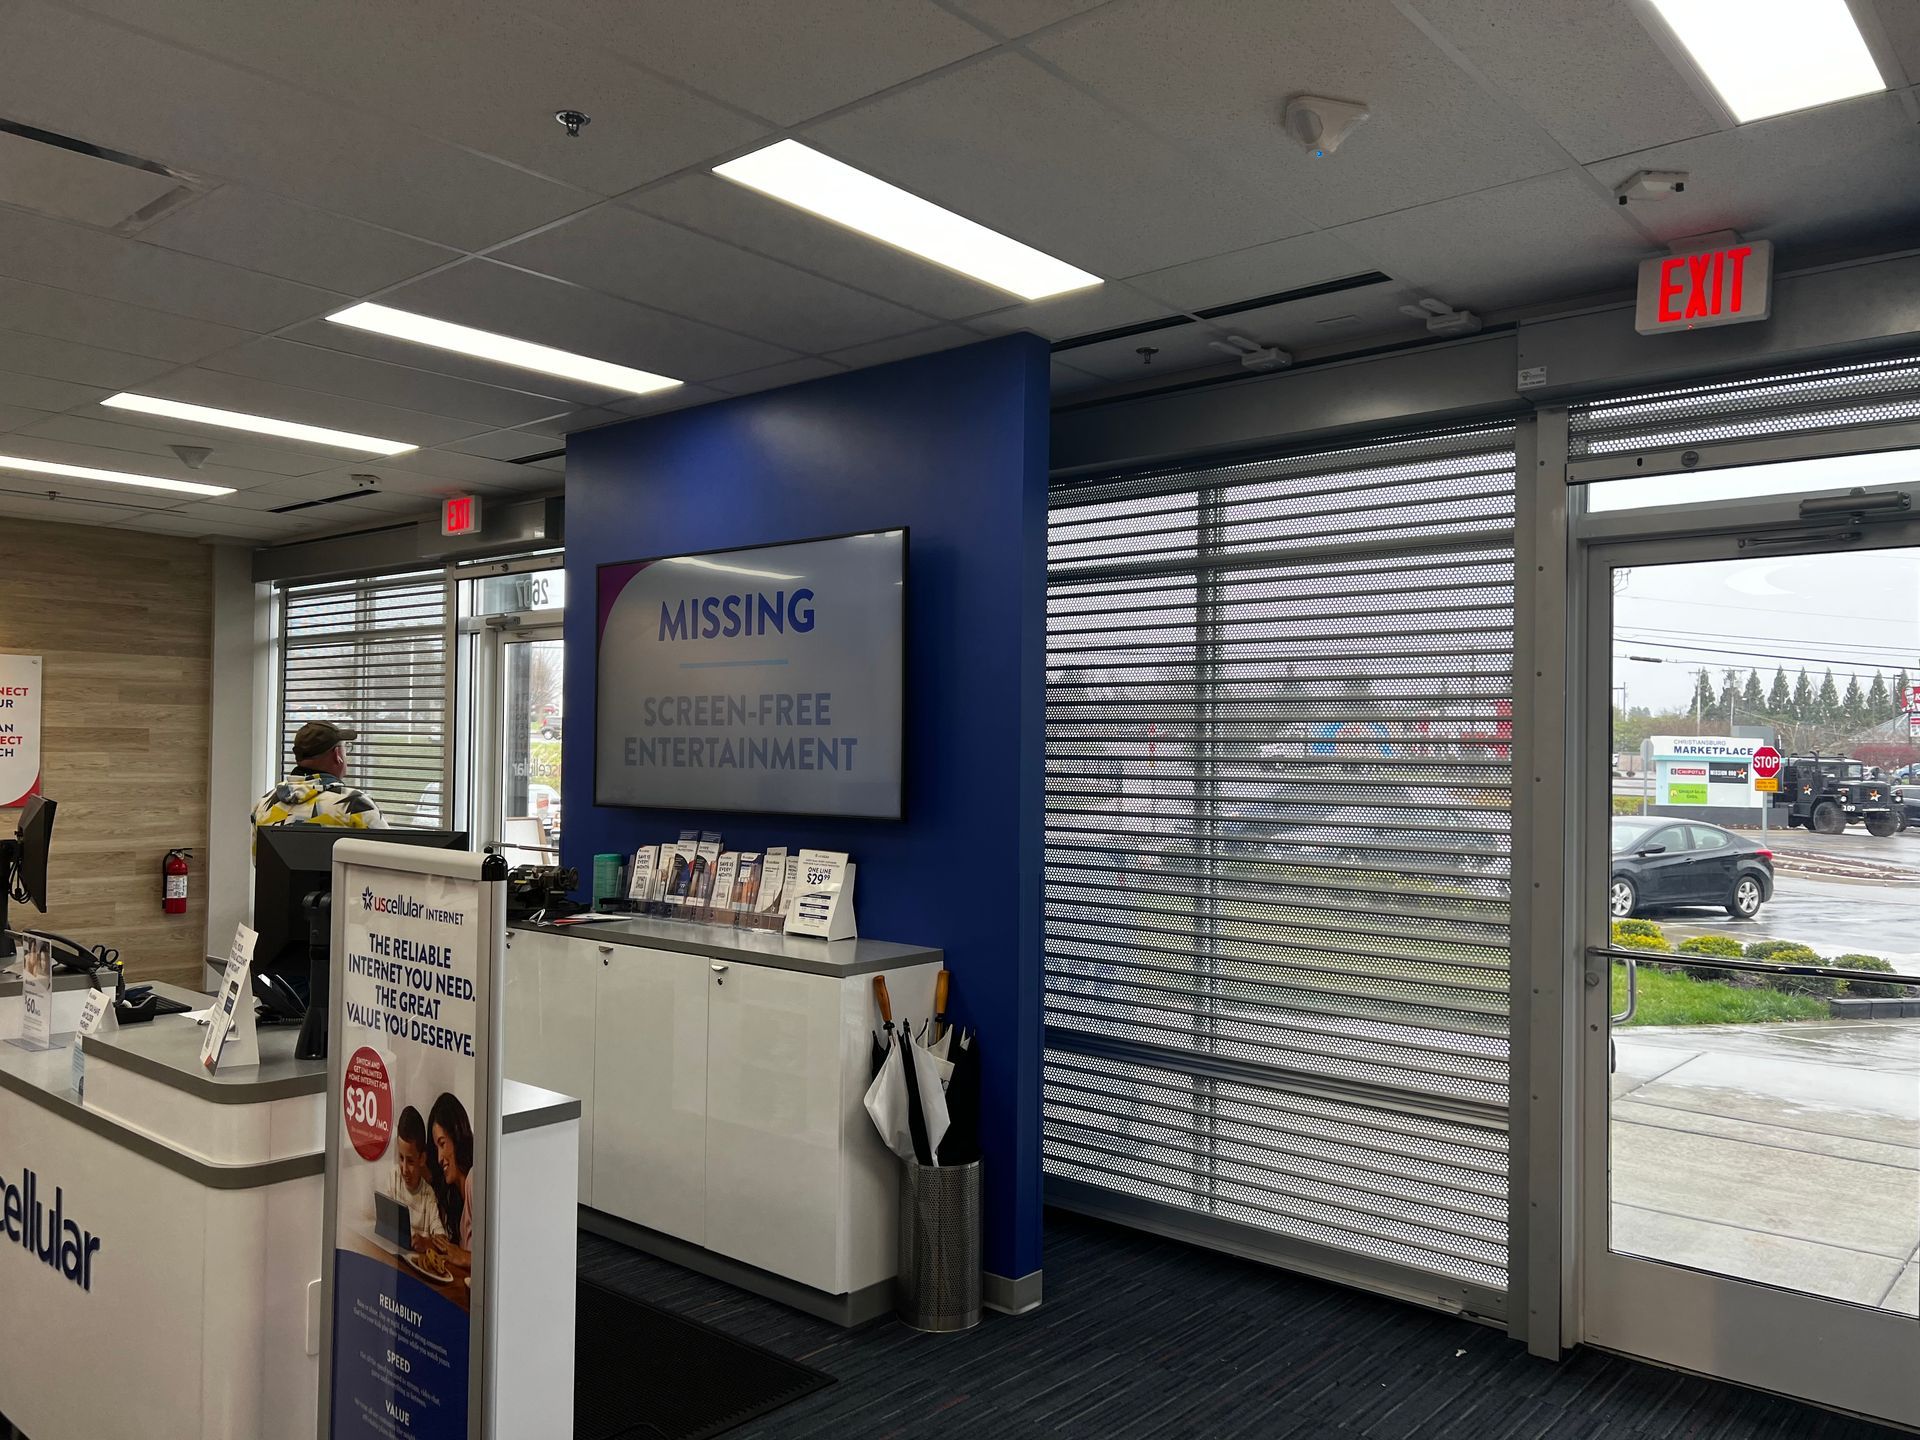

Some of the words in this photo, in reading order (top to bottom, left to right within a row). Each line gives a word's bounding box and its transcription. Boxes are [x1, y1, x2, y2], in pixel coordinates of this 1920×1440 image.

[1658, 247, 1752, 322] EXIT
[447, 497, 473, 532] EXIT
[658, 588, 815, 642] MISSING
[644, 693, 831, 727] SCREEN-FREE
[624, 737, 857, 771] ENTERTAINMENT
[1673, 746, 1753, 756] MARKETPLACE
[1754, 756, 1779, 768] STOP
[808, 866, 819, 874] ONE
[819, 867, 832, 875] LINE
[374, 894, 424, 919] uscellular
[425, 908, 464, 926] INTERNET
[369, 933, 391, 957] THE
[393, 938, 452, 969] RELIABLE
[348, 953, 403, 985] INTERNET
[404, 965, 432, 991] YOU
[436, 973, 476, 1003] NEED.
[375, 984, 397, 1010] THE
[399, 991, 441, 1021] GREAT
[346, 1001, 381, 1031] VALUE
[383, 1012, 408, 1038] YOU
[411, 1020, 475, 1058] DESERVE.
[348, 1073, 360, 1083] HOME
[353, 1065, 361, 1073] GET
[356, 1056, 371, 1066] SWITCH
[379, 1293, 423, 1328] RELIABILITY
[386, 1349, 411, 1374] SPEED
[385, 1399, 410, 1427] VALUE
